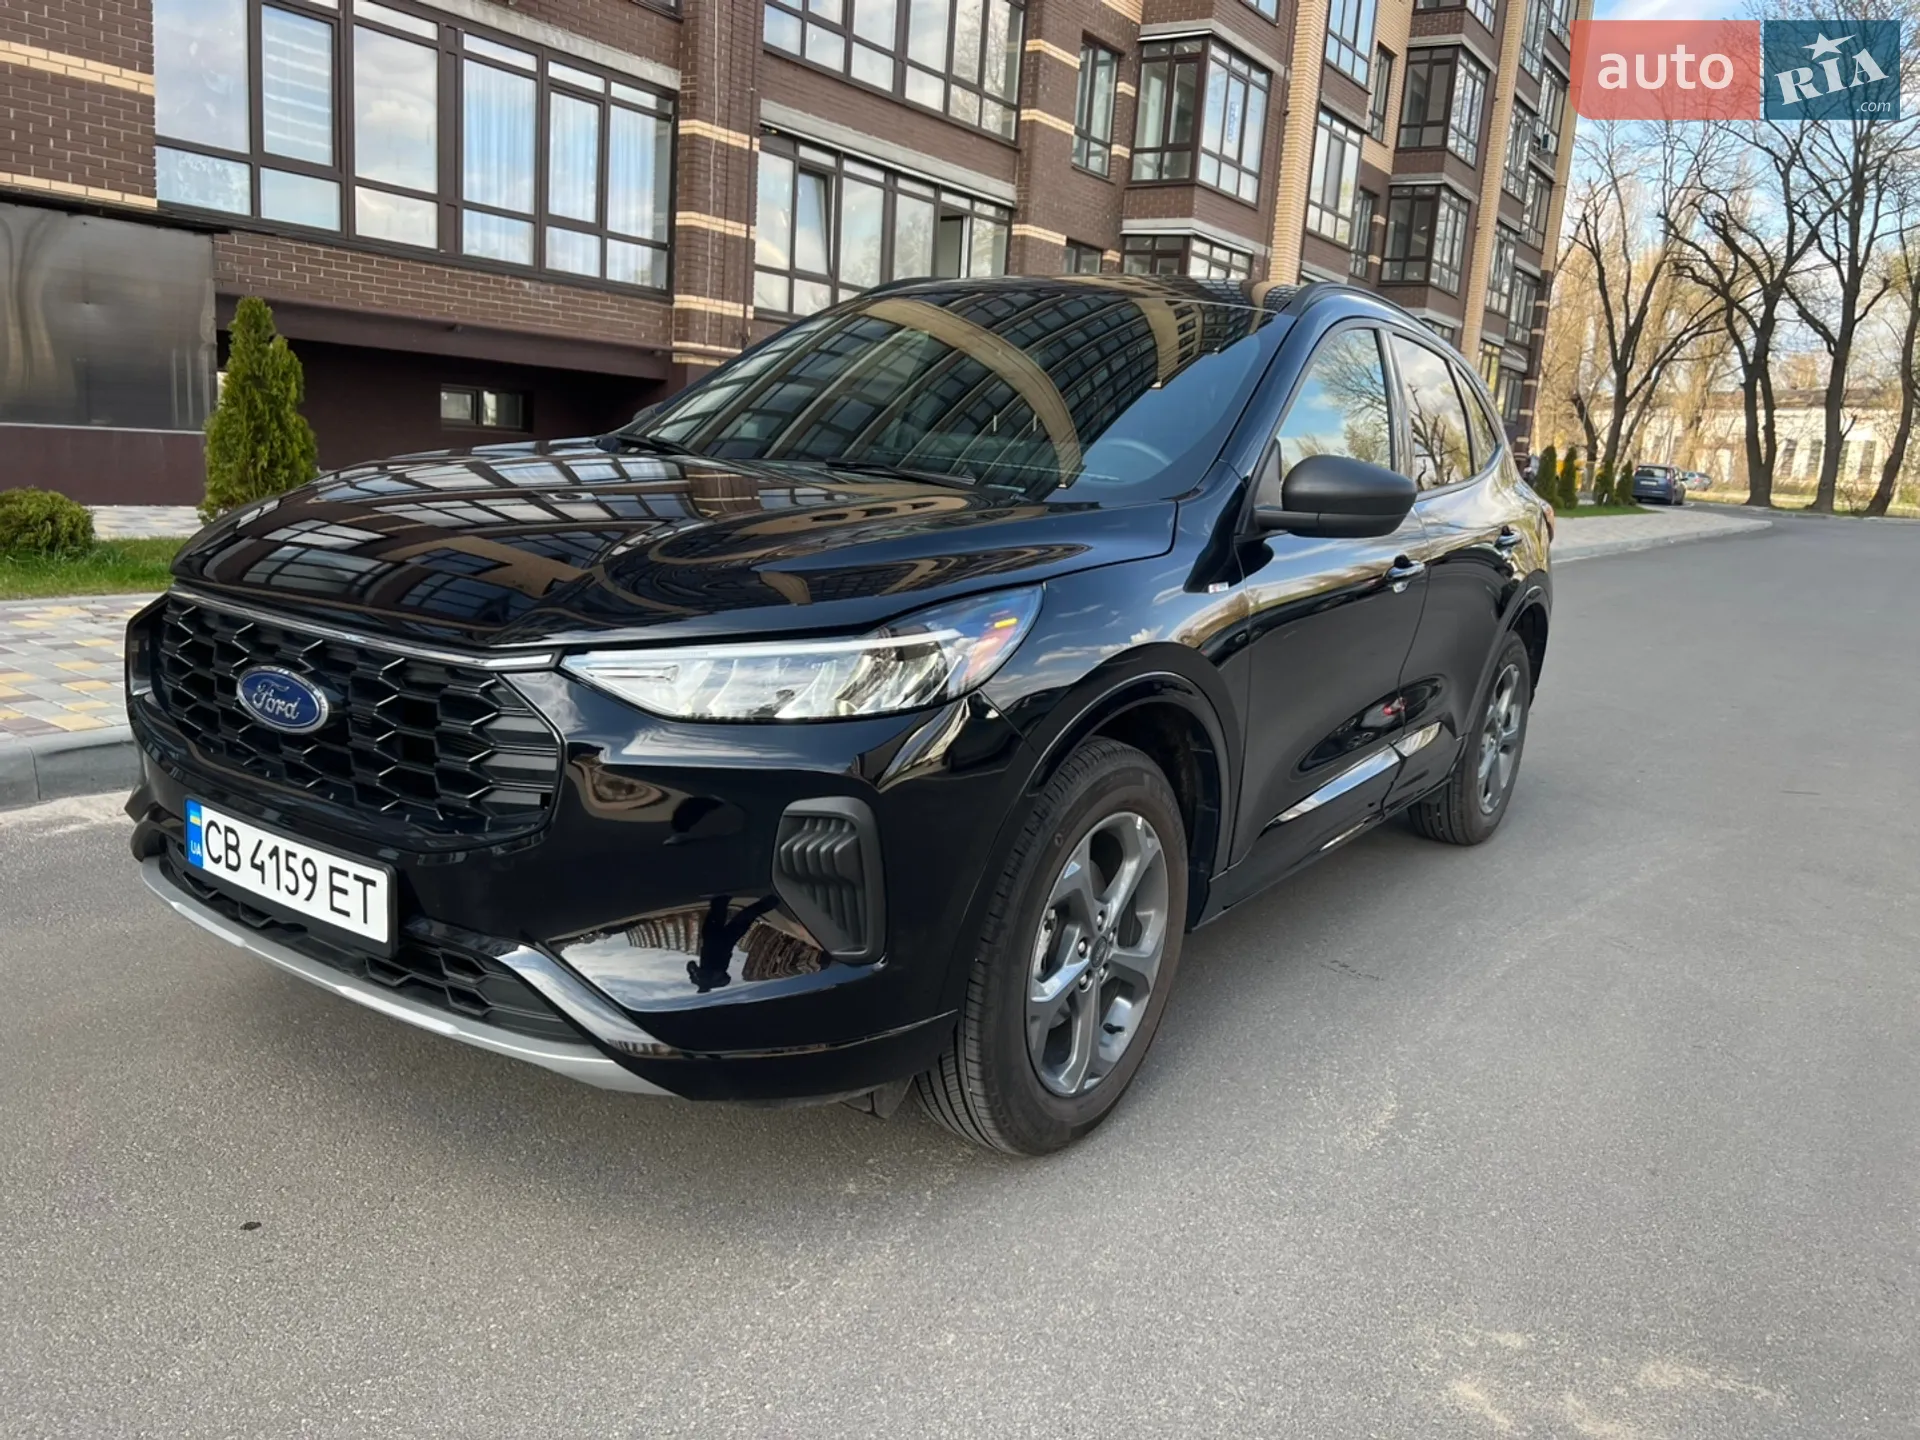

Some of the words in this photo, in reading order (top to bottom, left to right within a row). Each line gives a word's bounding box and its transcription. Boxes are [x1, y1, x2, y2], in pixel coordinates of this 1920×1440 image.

[252, 679, 301, 720] Ford
[190, 840, 202, 857] UA
[205, 820, 242, 873] CB
[250, 839, 318, 901] 4159
[329, 865, 377, 925] ET
